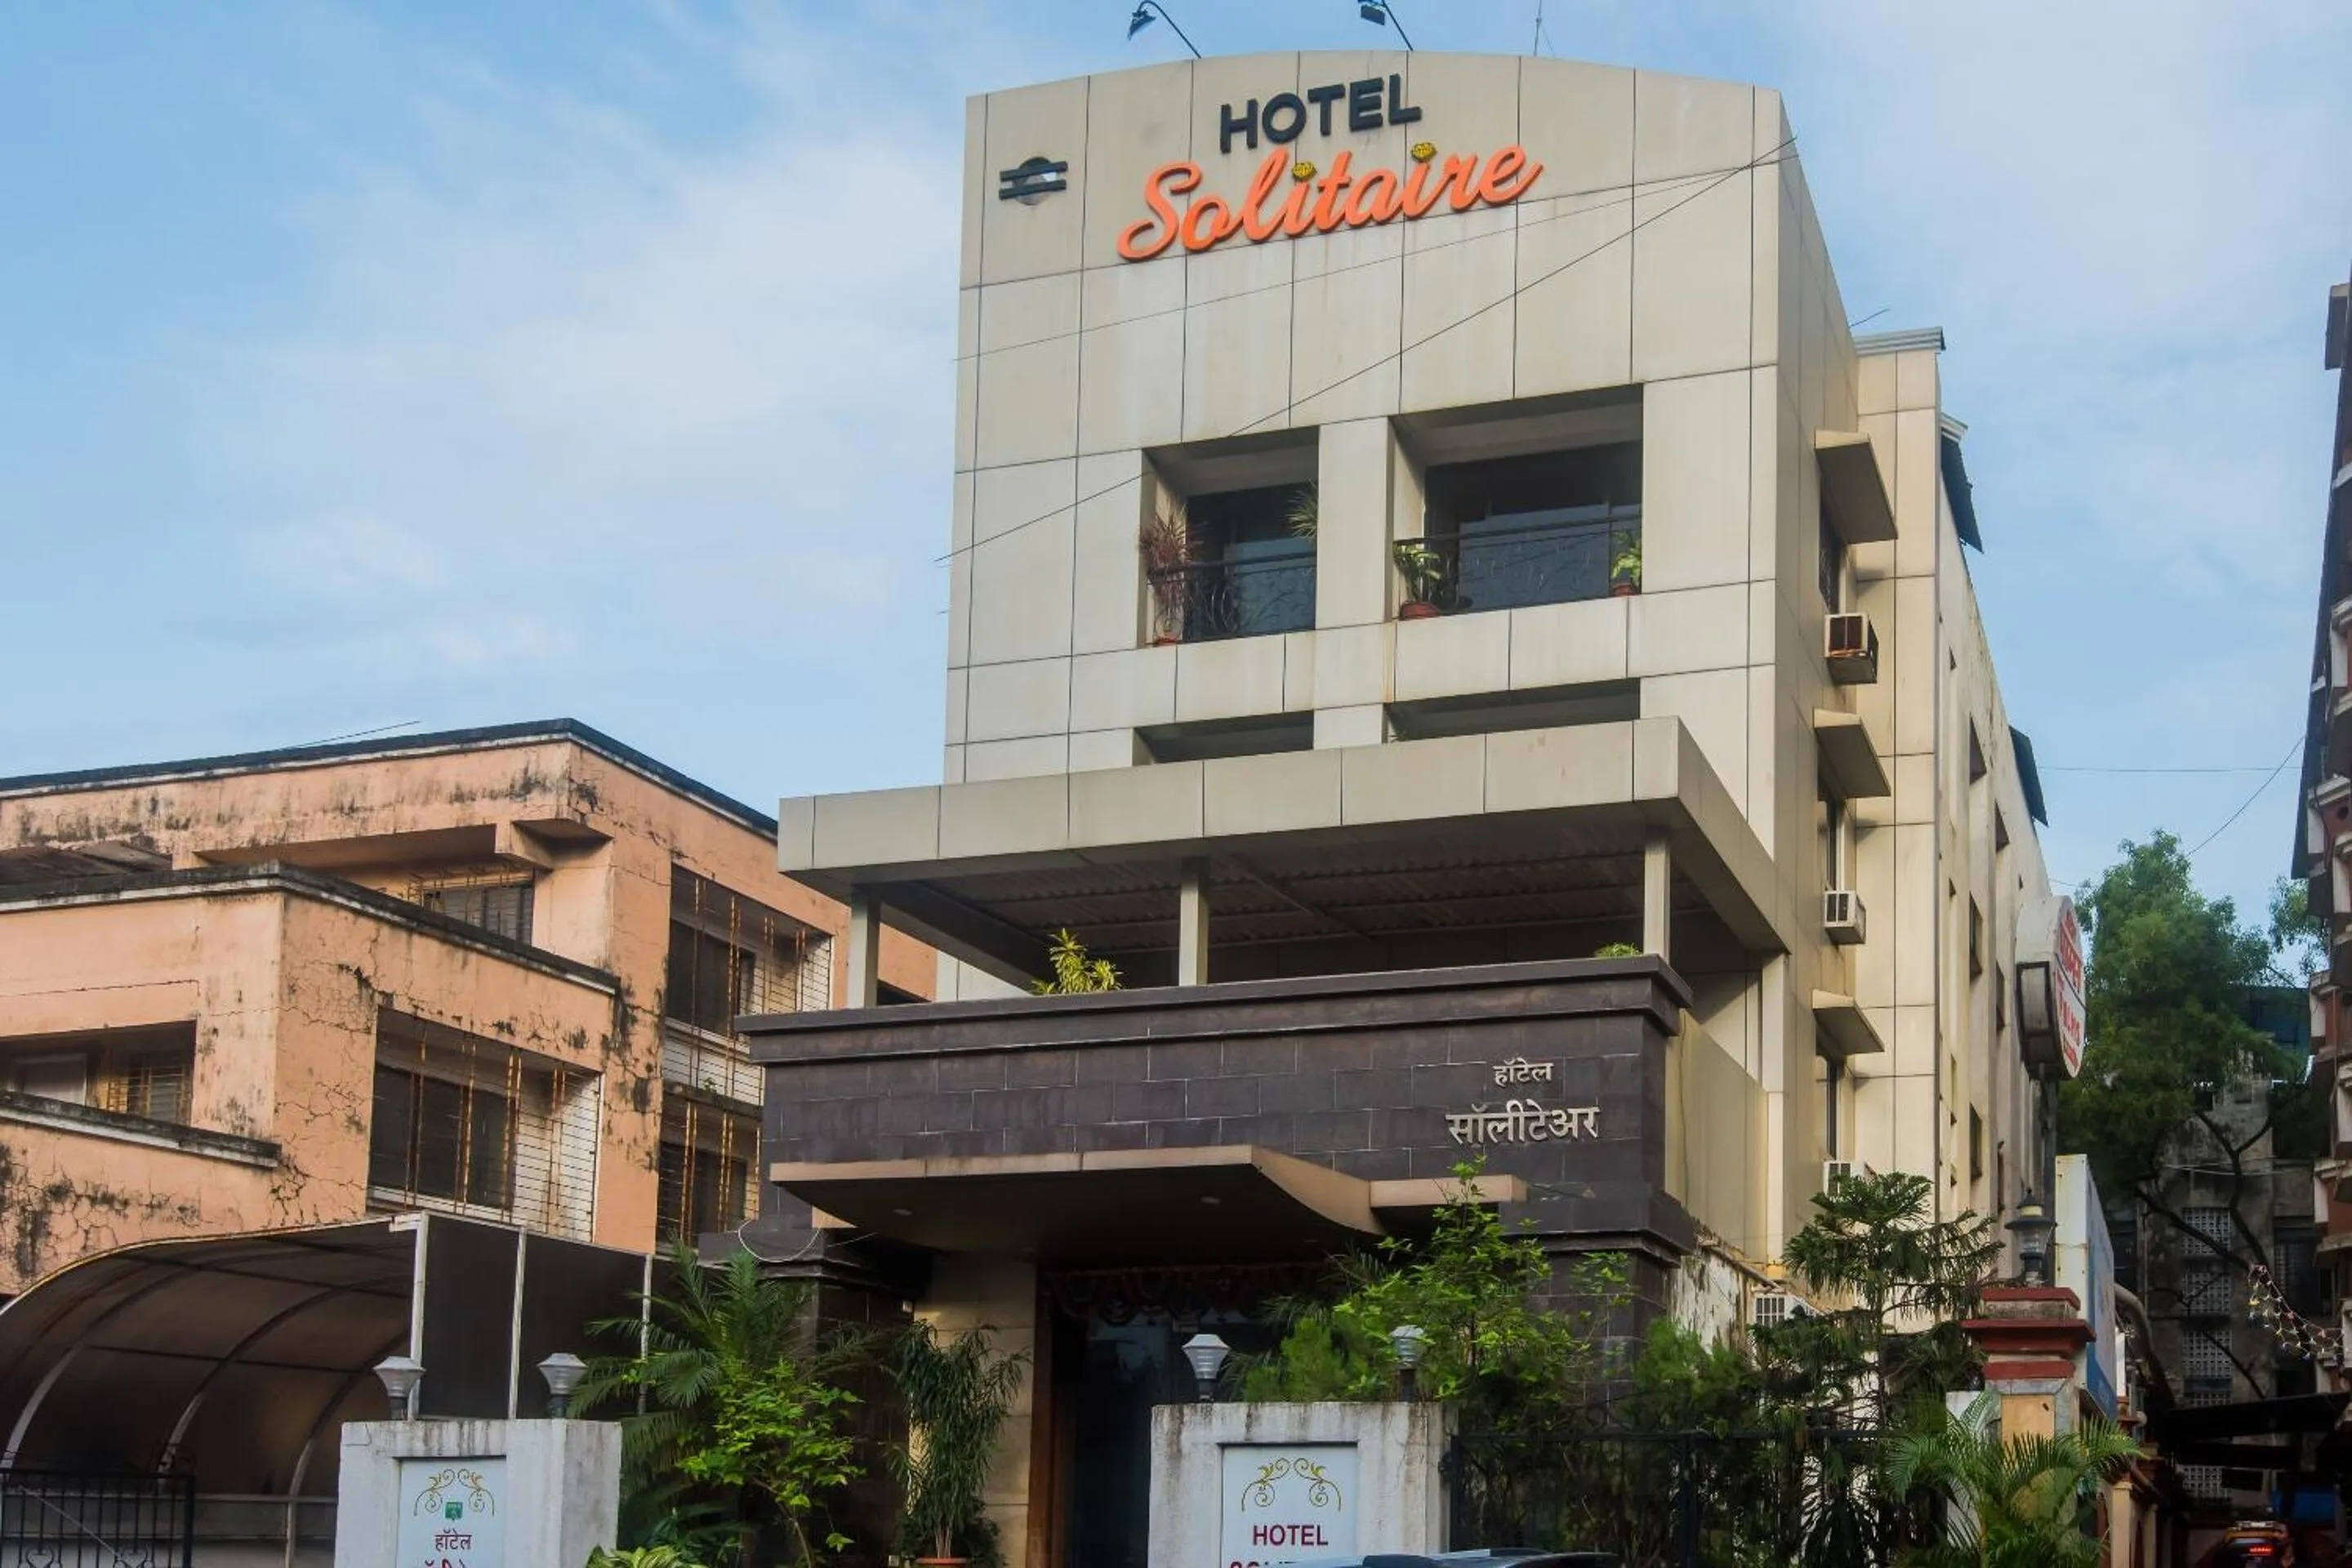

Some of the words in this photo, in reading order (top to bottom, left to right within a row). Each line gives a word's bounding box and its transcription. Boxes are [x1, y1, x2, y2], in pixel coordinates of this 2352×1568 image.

[1219, 74, 1422, 154] HOTEL
[1116, 141, 1544, 262] Solitaire
[1492, 1058, 1553, 1086] हॉटेल
[1445, 1099, 1601, 1144] सॉलीटेअर
[434, 1528, 473, 1552] हॉटेल
[1253, 1524, 1329, 1546] HOTEL
